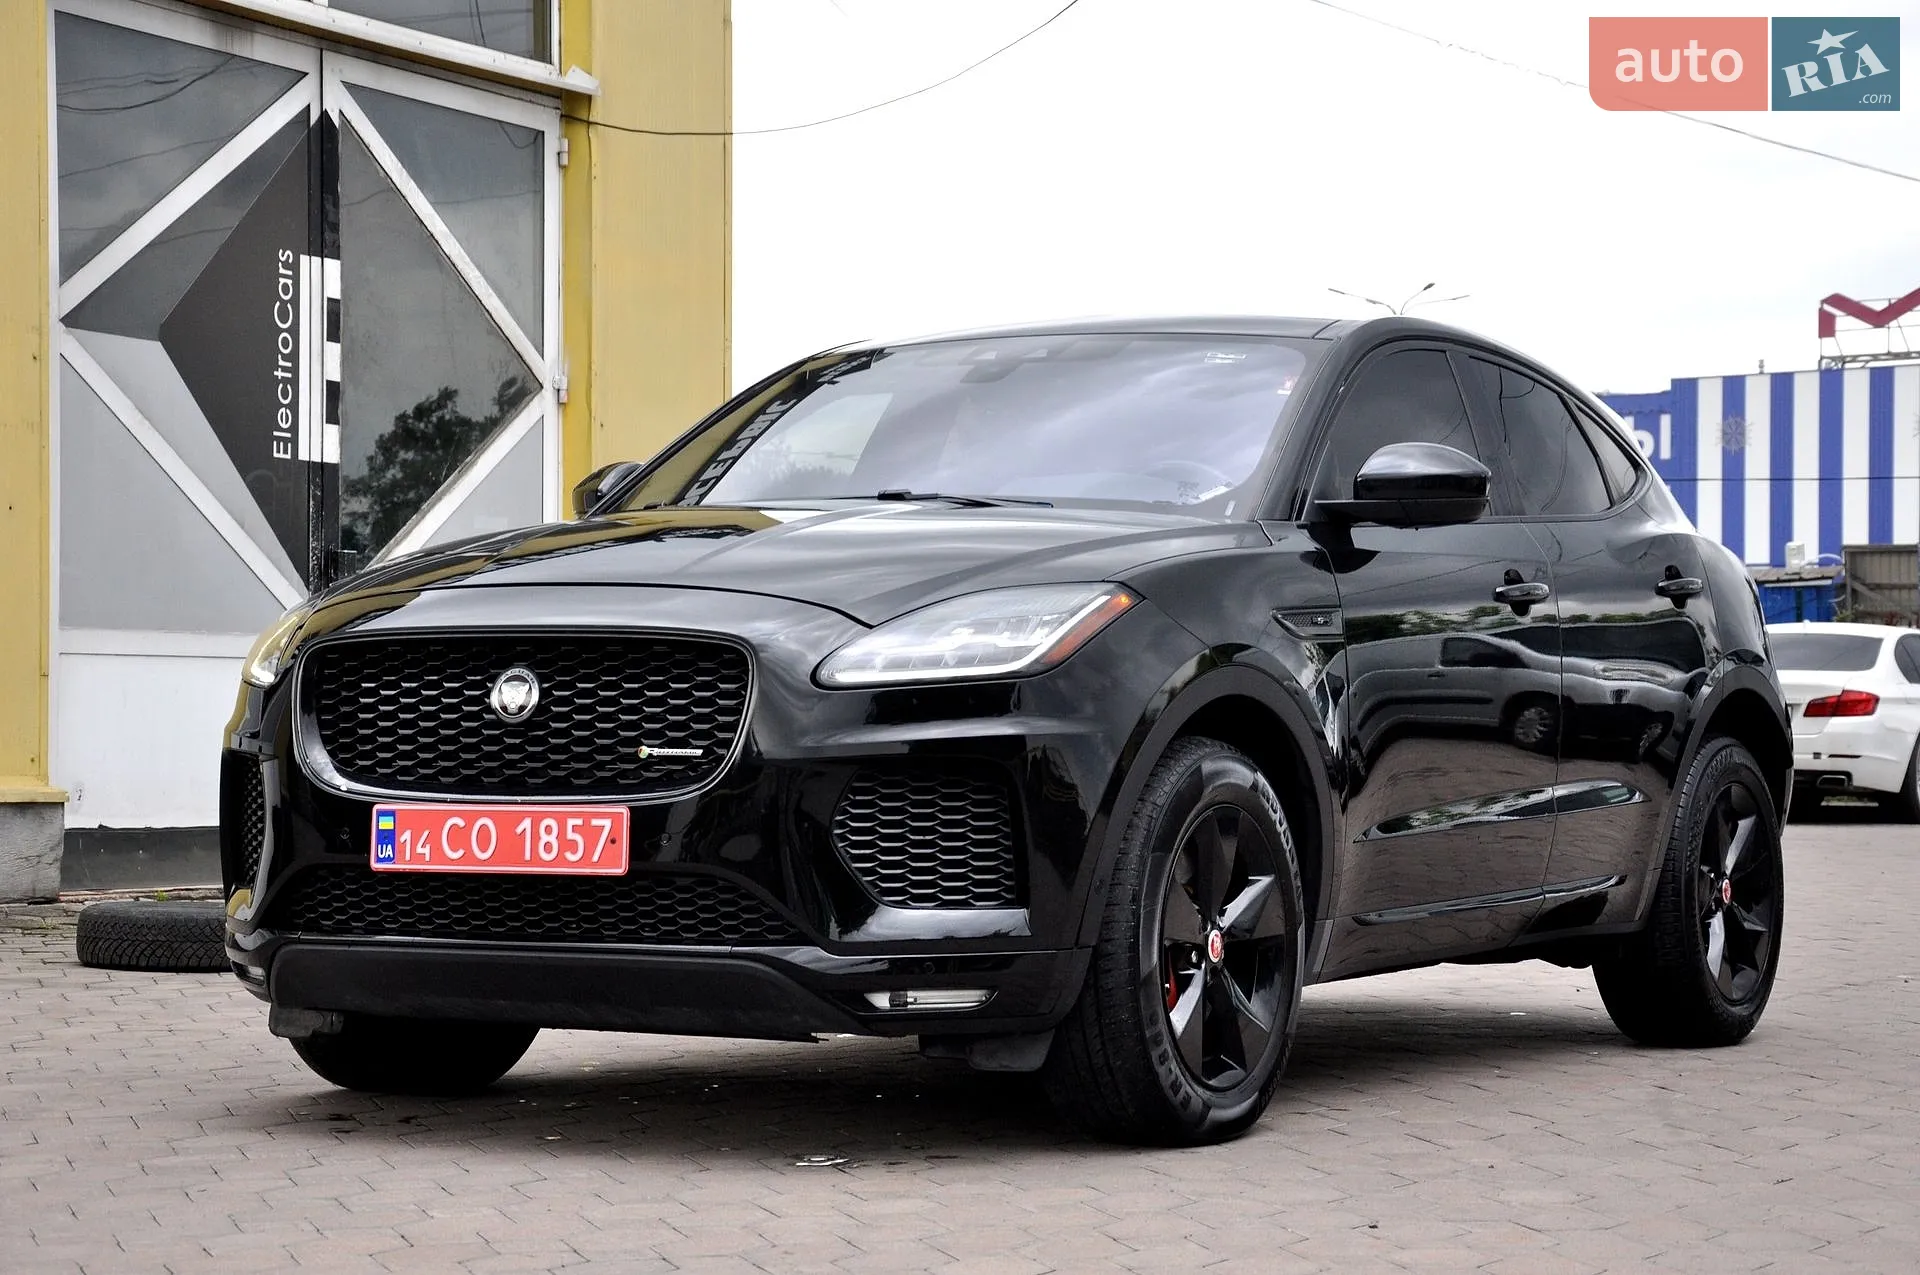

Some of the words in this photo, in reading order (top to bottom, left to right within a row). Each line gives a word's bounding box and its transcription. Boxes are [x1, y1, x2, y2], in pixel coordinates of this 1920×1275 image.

[273, 248, 294, 459] ElectroCars
[377, 843, 394, 858] UA
[400, 829, 432, 862] 14
[441, 815, 498, 861] CO
[515, 816, 613, 863] 1857
